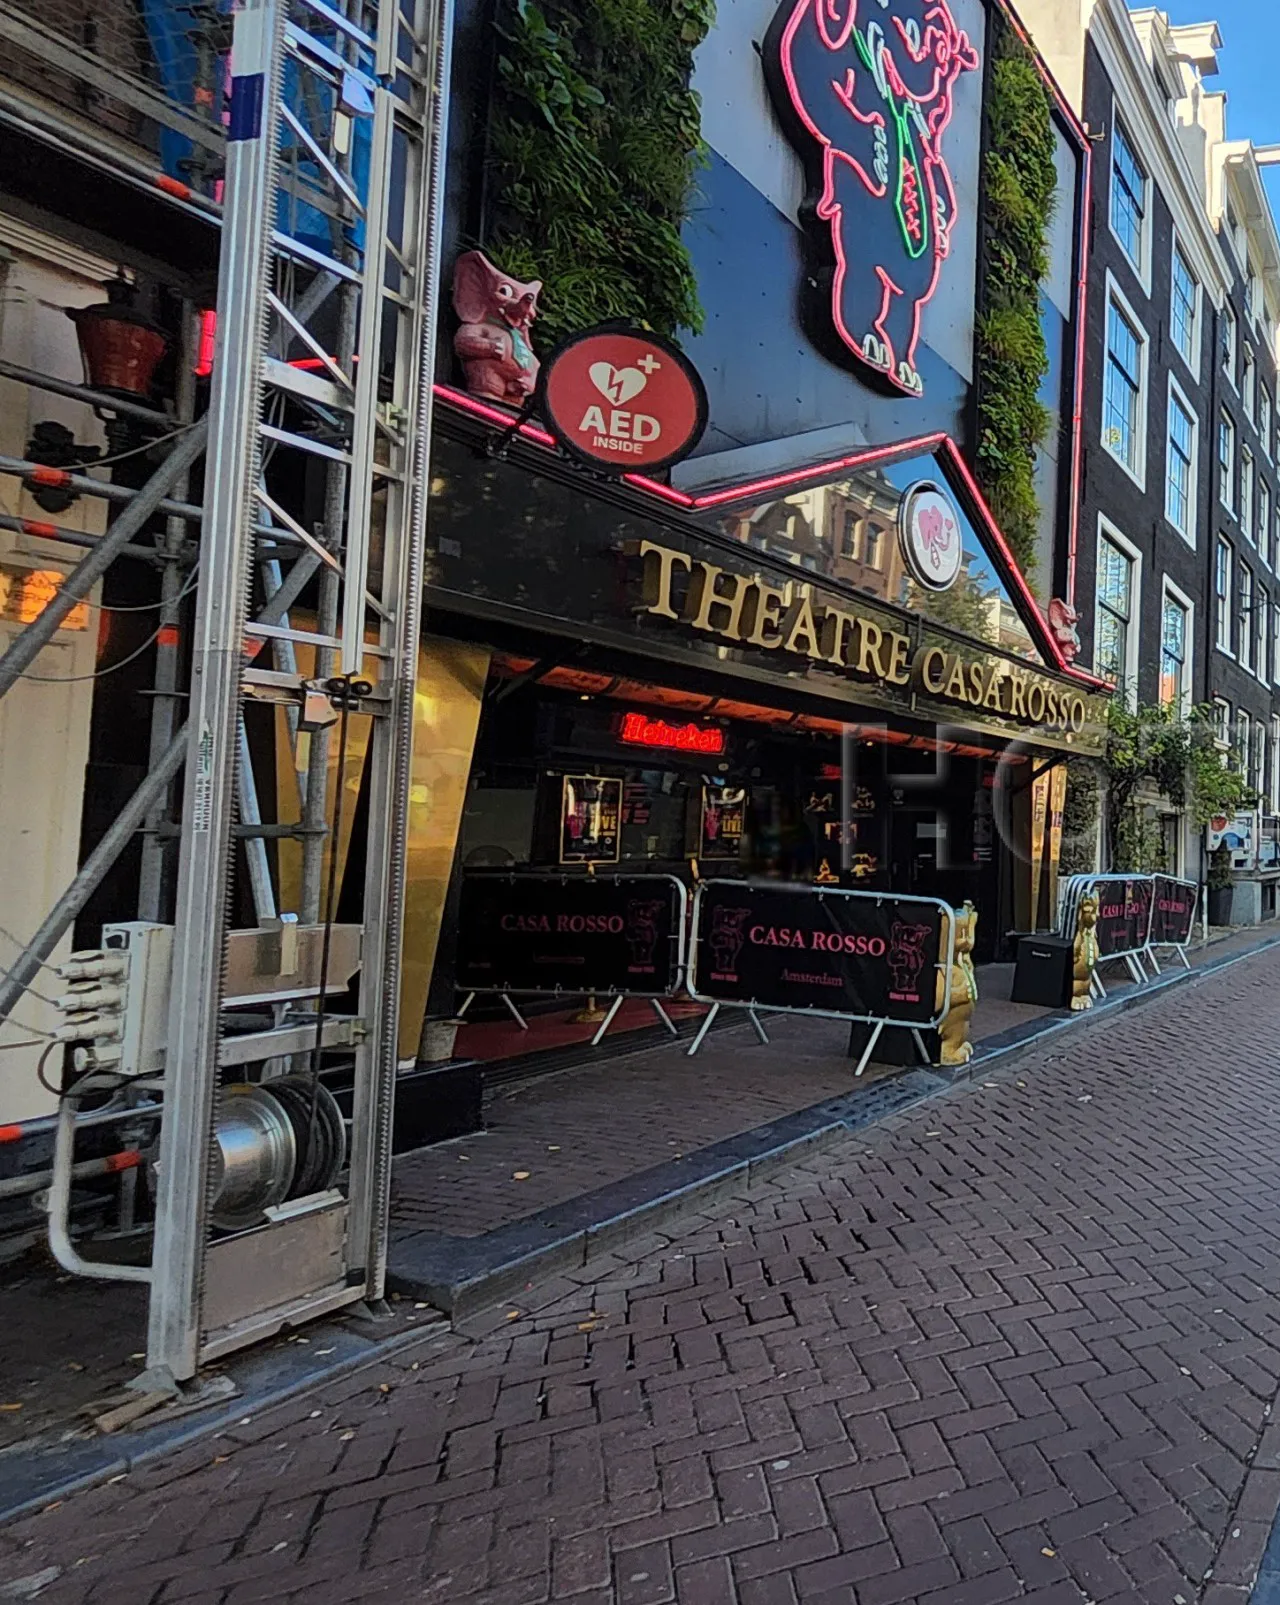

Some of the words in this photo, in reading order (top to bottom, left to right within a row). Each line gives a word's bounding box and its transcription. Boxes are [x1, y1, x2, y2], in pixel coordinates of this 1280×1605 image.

[579, 405, 661, 442] AED
[592, 436, 644, 455] INSIDE
[639, 539, 910, 686] THEATRE
[922, 646, 1006, 709] CASA
[1009, 673, 1086, 734] ROSSO
[623, 713, 723, 752] Heineken
[499, 913, 551, 933] CASA
[556, 914, 625, 934] ROSSO
[749, 925, 807, 949] CASA
[812, 931, 886, 957] ROSSO
[780, 967, 844, 988] Amsterdam
